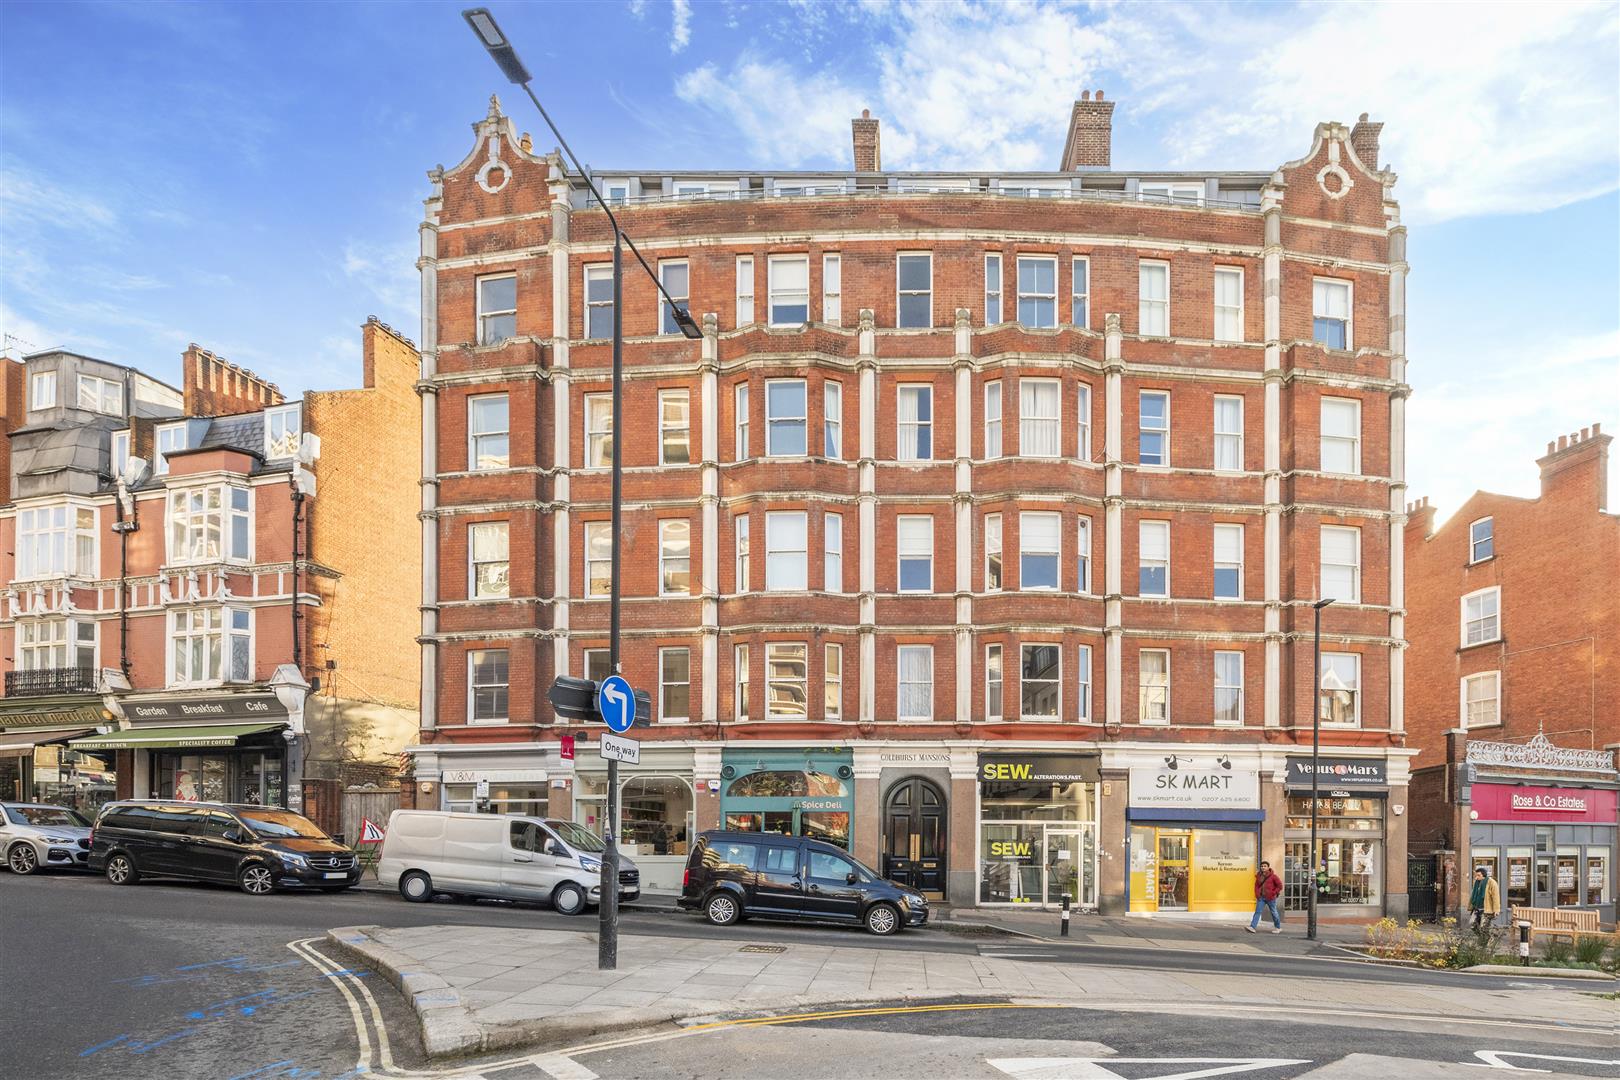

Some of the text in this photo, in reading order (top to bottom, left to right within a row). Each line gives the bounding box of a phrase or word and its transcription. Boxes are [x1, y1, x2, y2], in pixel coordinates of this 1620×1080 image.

[136, 701, 269, 716] Garden Breakfast Cafe
[605, 741, 636, 758] One way
[451, 771, 475, 781] V&M
[1347, 765, 1378, 775] Mars
[1155, 774, 1233, 789] SK MART
[801, 801, 842, 809] Spice Deli
[1513, 795, 1585, 808] Rose & Co Estates
[1145, 869, 1155, 900] MART
